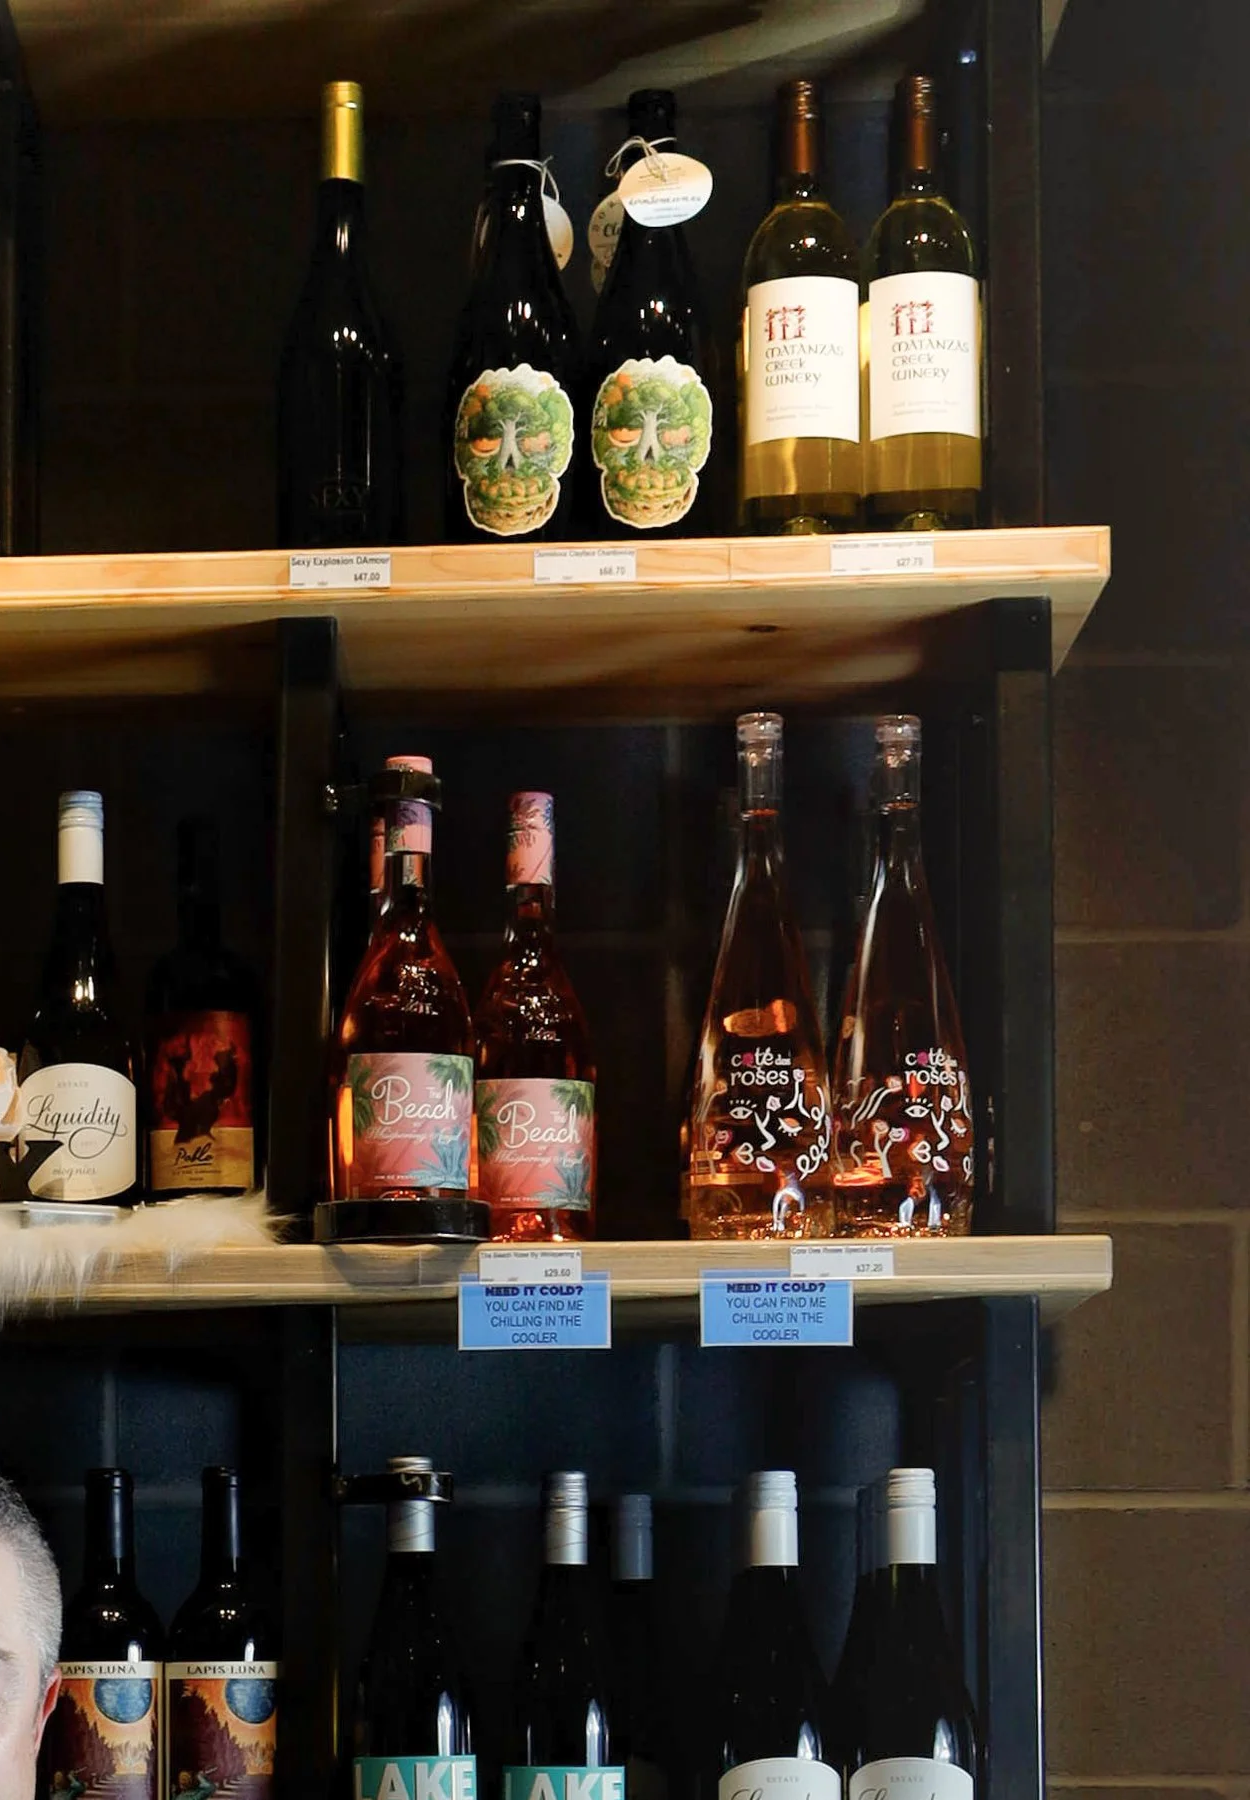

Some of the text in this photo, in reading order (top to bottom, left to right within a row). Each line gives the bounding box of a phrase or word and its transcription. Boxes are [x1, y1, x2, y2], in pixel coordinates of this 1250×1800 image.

[892, 338, 970, 354] MATANZAS
[765, 359, 805, 372] CREEK
[892, 353, 935, 367] CREEK
[765, 370, 822, 387] WINERY
[892, 366, 950, 383] WINERY
[291, 557, 310, 568] Sexy
[313, 557, 354, 566] Explosion
[354, 572, 381, 581] $47.00
[730, 1067, 790, 1086] roses
[905, 1067, 957, 1086] roses
[371, 1075, 458, 1126] Beach
[24, 1094, 128, 1142] Liquidity
[496, 1100, 582, 1150] Beach
[485, 1285, 583, 1297] NEED IT COLD?
[726, 1282, 826, 1293] NEED IT COLD?
[485, 1299, 583, 1312] YOU CAN FIND ME
[726, 1296, 826, 1309] YOU CAN FIND ME
[491, 1315, 581, 1328] CHILLING IN THE
[732, 1312, 823, 1325] CHILLING IN THE
[512, 1332, 558, 1344] COOLER
[752, 1329, 799, 1341] COOLER
